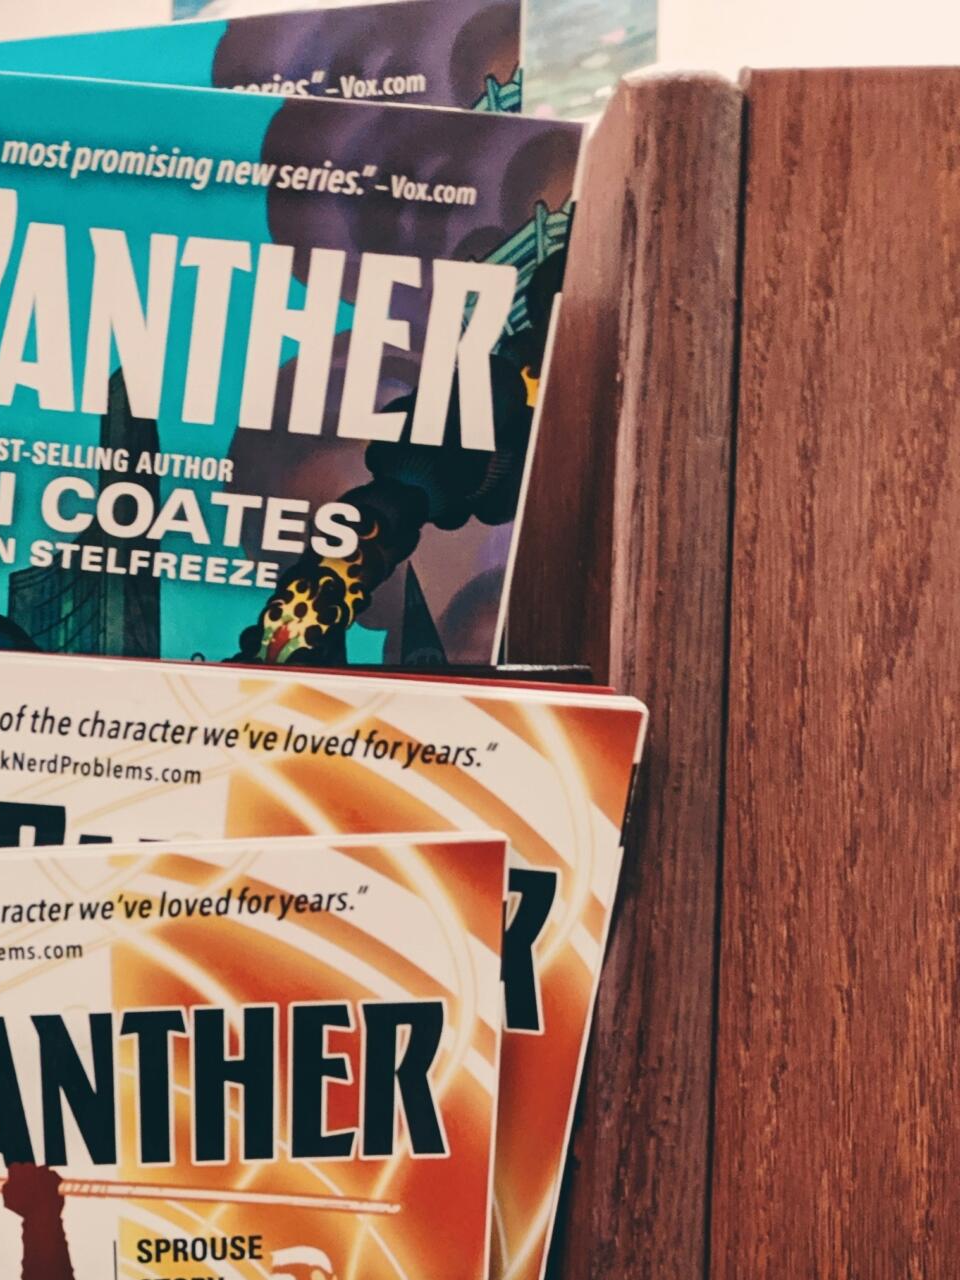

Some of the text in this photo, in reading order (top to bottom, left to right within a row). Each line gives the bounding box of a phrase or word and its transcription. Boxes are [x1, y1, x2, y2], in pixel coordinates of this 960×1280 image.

[2, 141, 71, 170] most
[71, 145, 213, 190] promising
[216, 159, 275, 187] new
[135, 452, 234, 482] AUTHOR
[41, 476, 362, 558] COATES
[29, 540, 279, 589] STELFREEZE
[0, 703, 30, 733] of
[30, 706, 71, 738] the
[78, 710, 199, 747] character
[203, 722, 278, 752] we've
[282, 726, 359, 759] loved
[362, 731, 401, 761] for
[79, 894, 154, 921] we've
[159, 886, 230, 918] loved
[238, 885, 276, 915] for
[137, 1235, 263, 1263] SPROUSE
